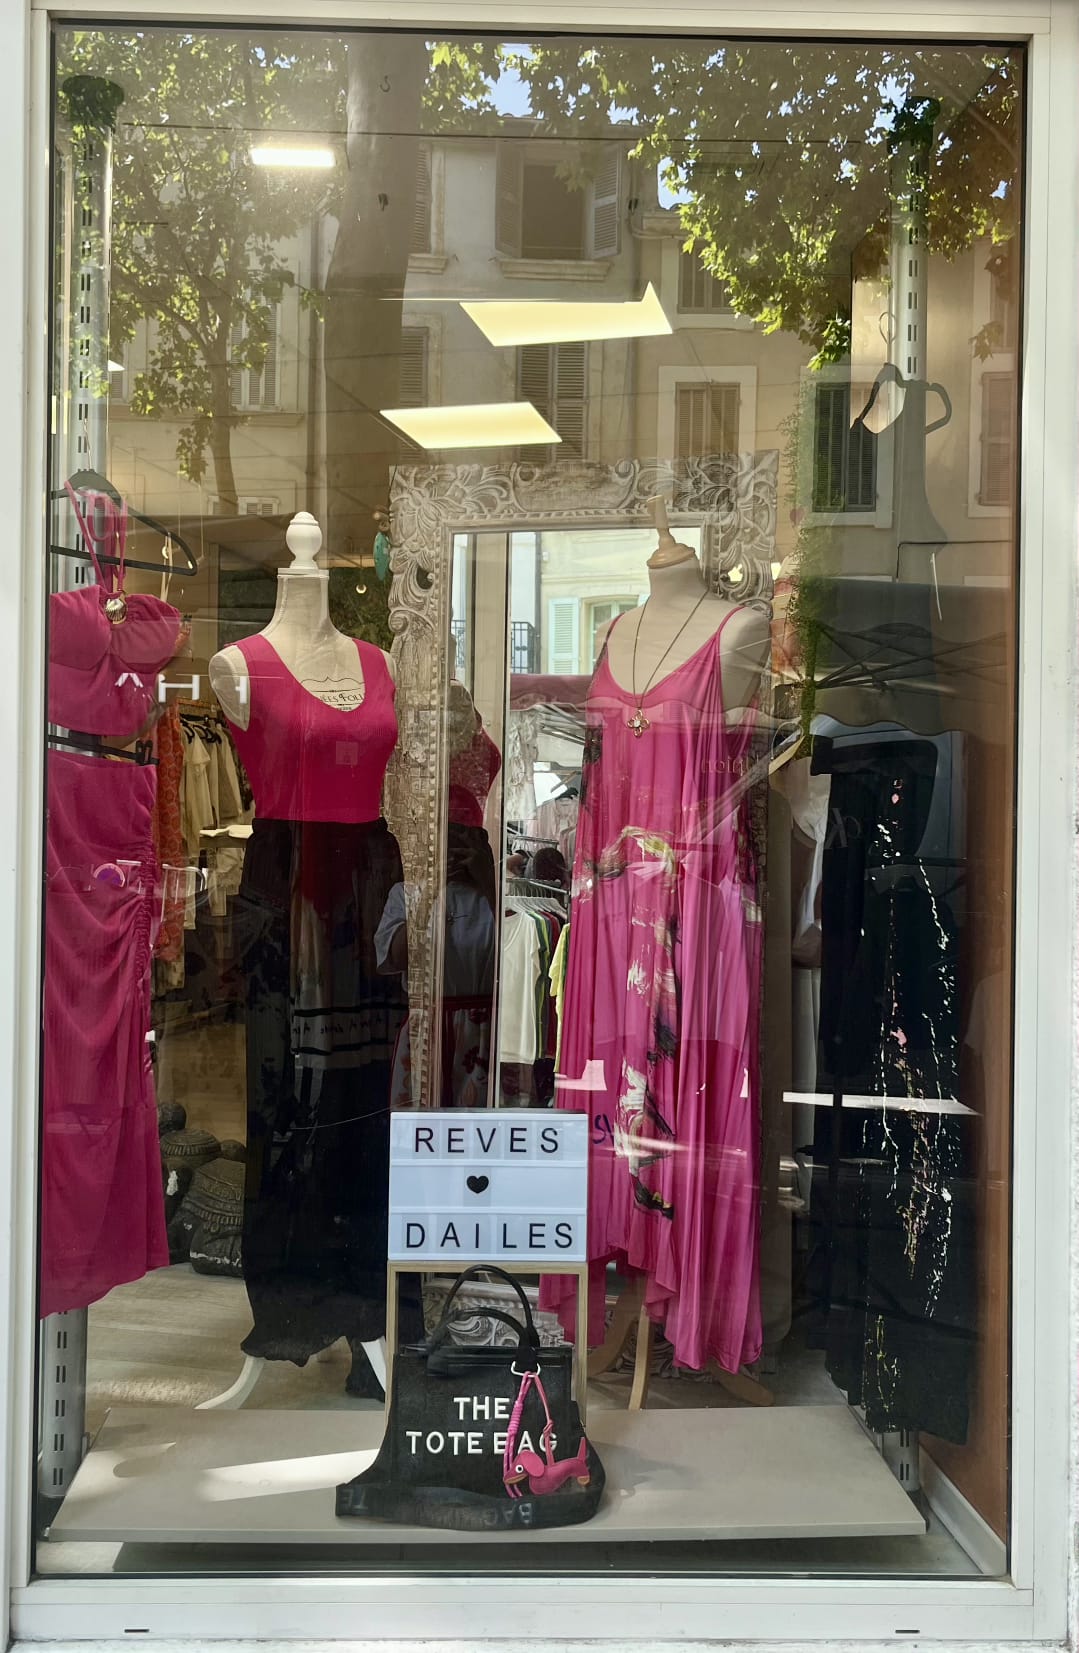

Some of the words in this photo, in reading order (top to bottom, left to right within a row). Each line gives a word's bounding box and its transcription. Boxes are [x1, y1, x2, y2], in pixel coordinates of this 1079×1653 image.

[414, 1127, 559, 1153] REVES
[406, 1222, 573, 1249] DAILES
[453, 1396, 510, 1420] THE
[405, 1431, 483, 1455] TOTE
